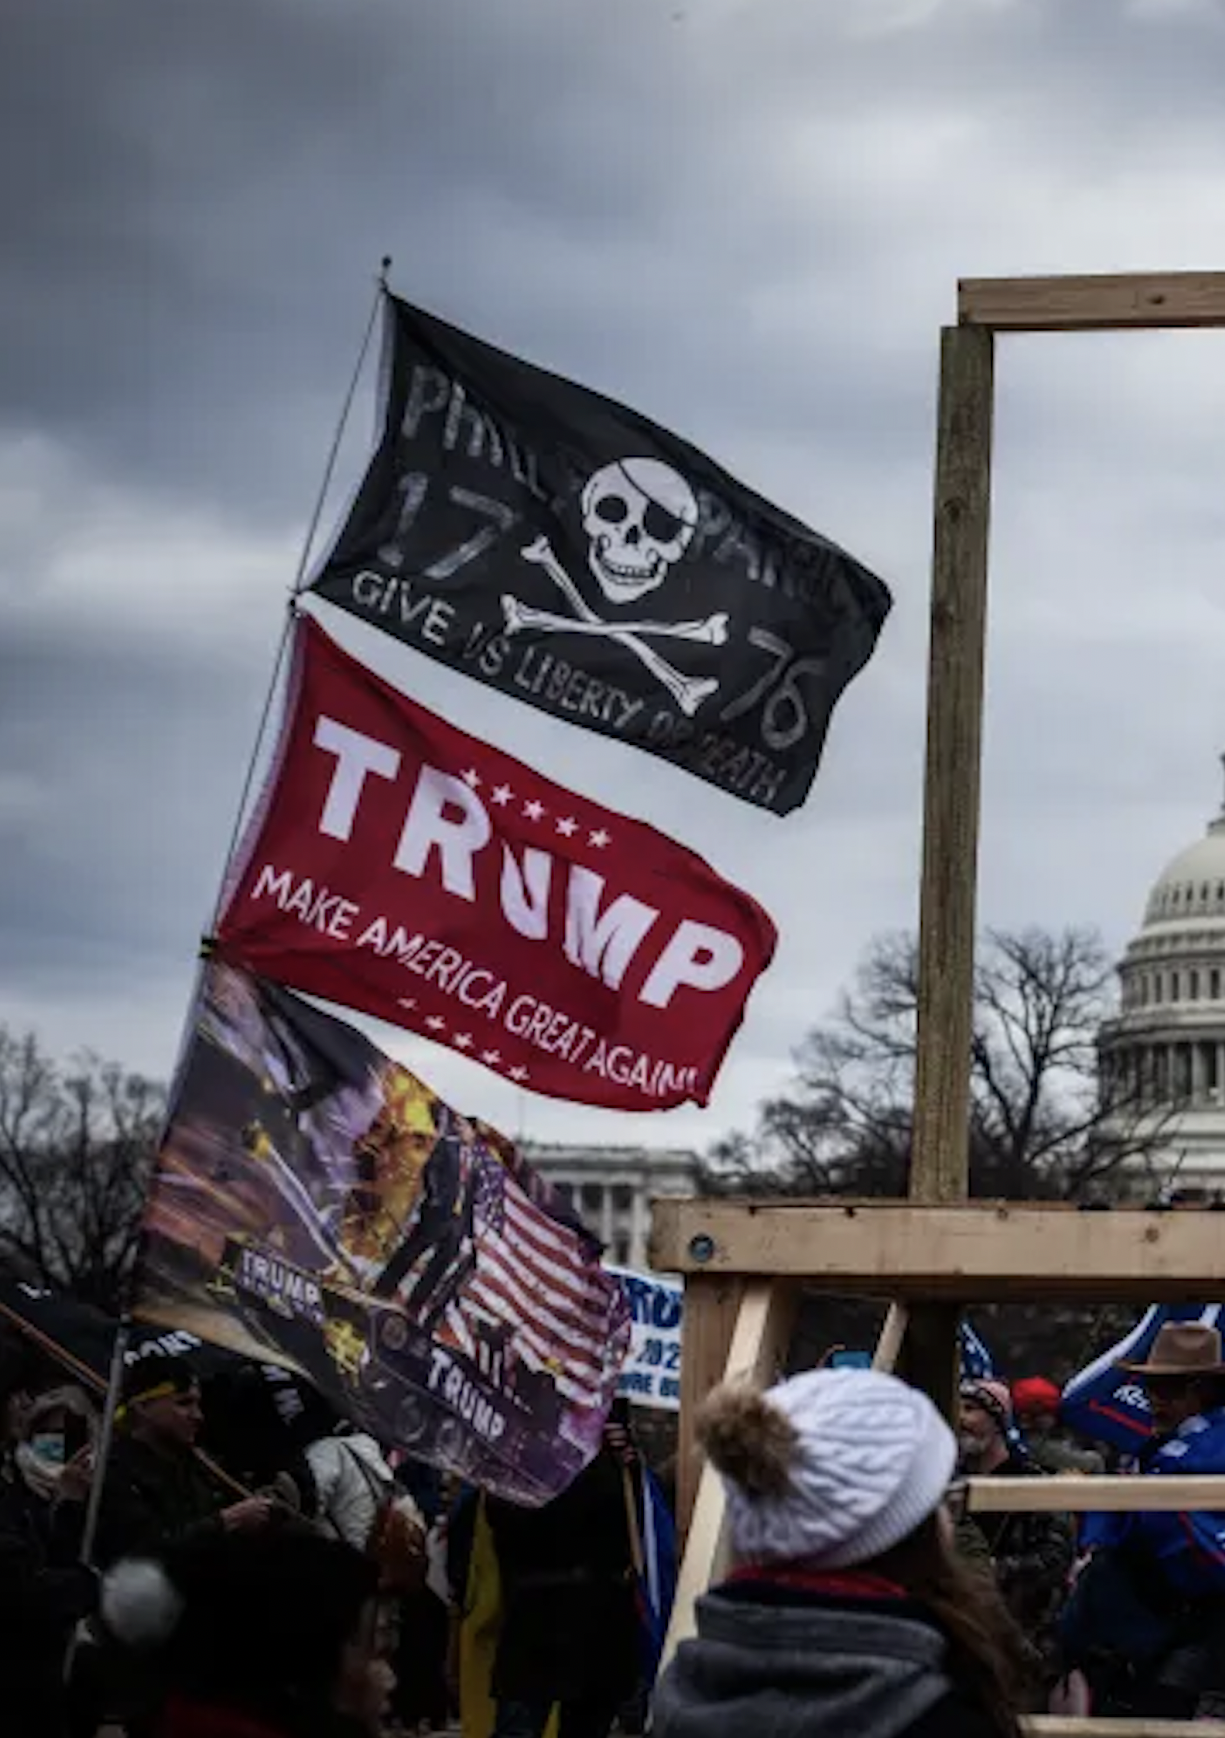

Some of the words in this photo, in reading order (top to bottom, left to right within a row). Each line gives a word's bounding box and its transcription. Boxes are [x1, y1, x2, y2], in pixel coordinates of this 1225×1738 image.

[352, 569, 456, 647] GIVE
[513, 646, 644, 728] LIBERTY
[729, 626, 827, 750] 76
[312, 715, 745, 1009] TRUMP
[252, 864, 360, 941] MAKE
[355, 915, 506, 1019] AMERICA
[504, 994, 596, 1064] GREAT
[241, 1248, 322, 1308] TRUMP
[427, 1346, 507, 1440] TRUMP
